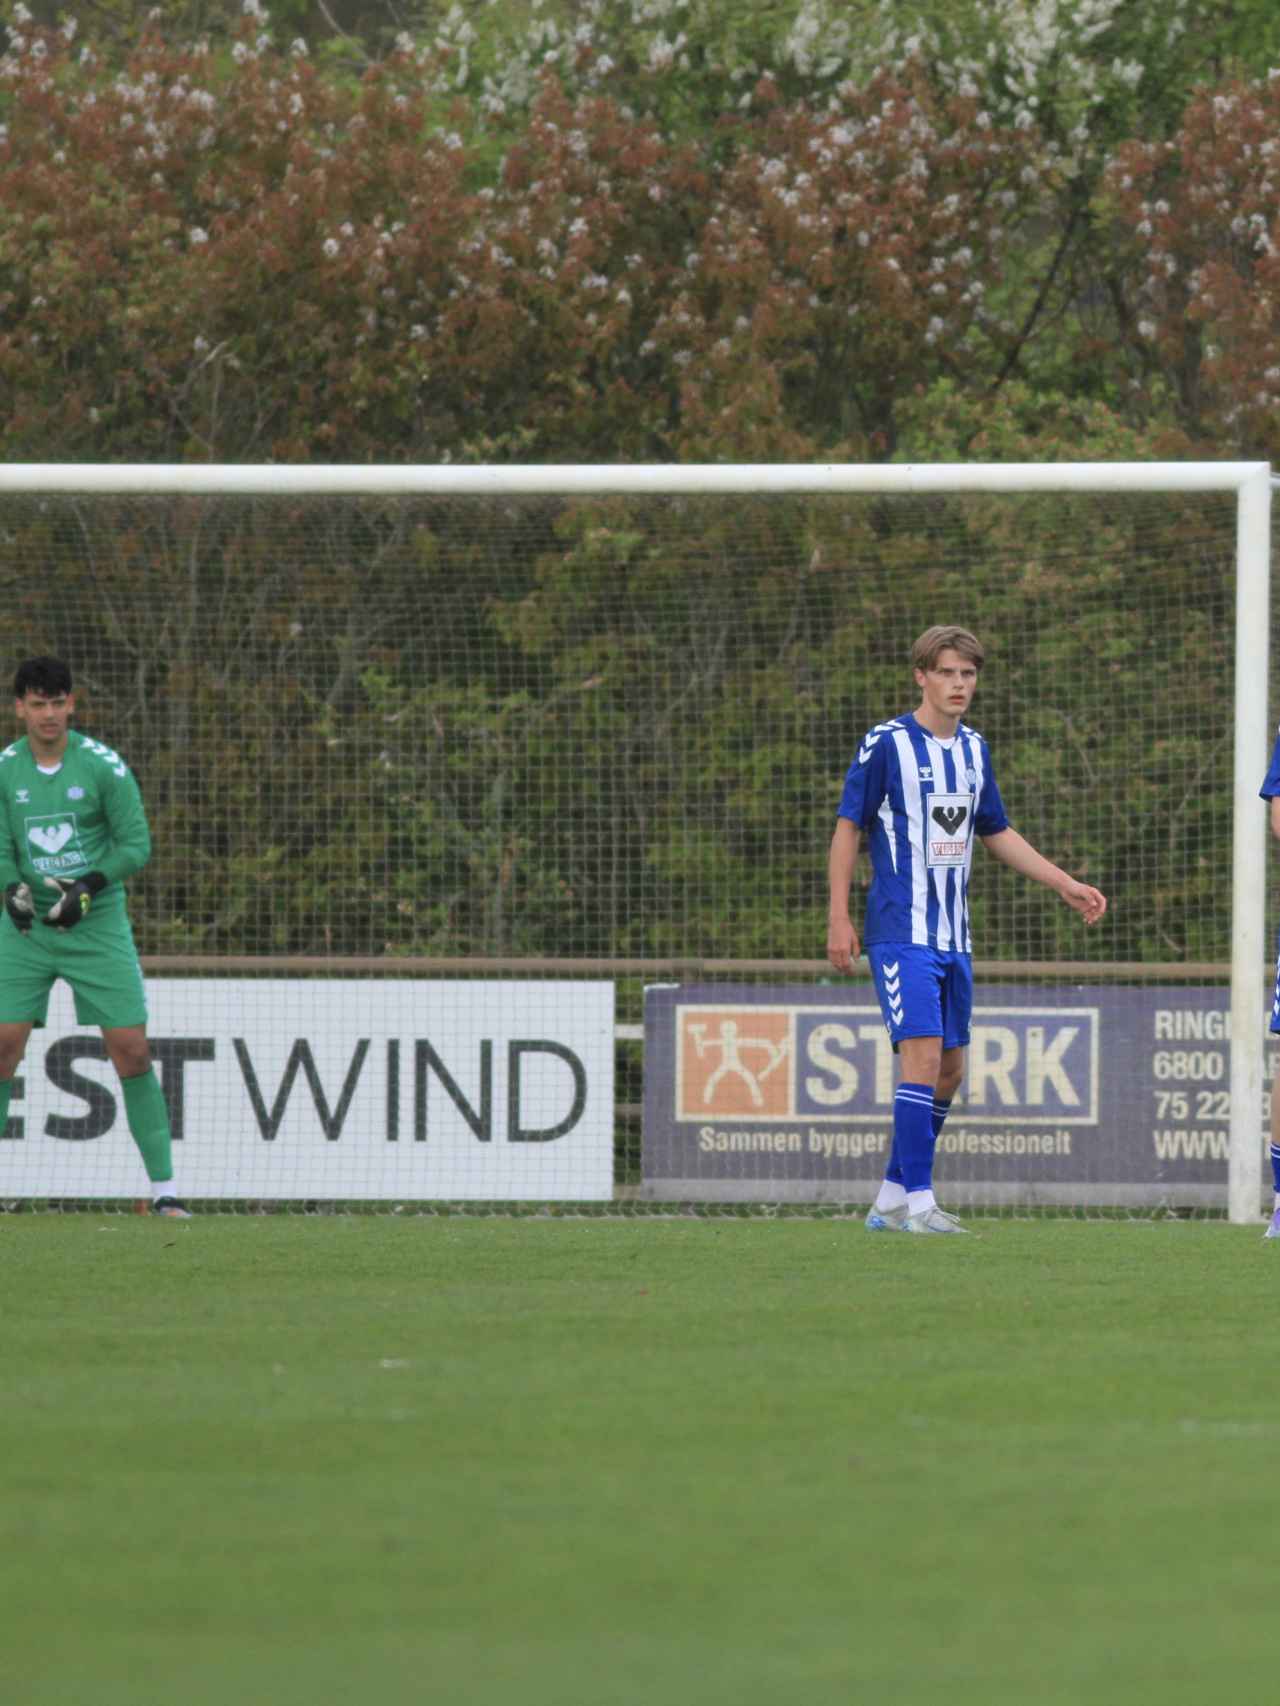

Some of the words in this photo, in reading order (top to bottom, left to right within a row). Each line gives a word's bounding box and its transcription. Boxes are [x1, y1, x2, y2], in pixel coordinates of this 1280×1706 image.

[806, 1023, 1080, 1106] STRK
[1153, 1051, 1224, 1080] 6800
[1153, 1091, 1188, 1120] 75
[700, 1126, 801, 1152] Sammen
[809, 1128, 887, 1157] bygger
[935, 1129, 1073, 1155] rofessionelt
